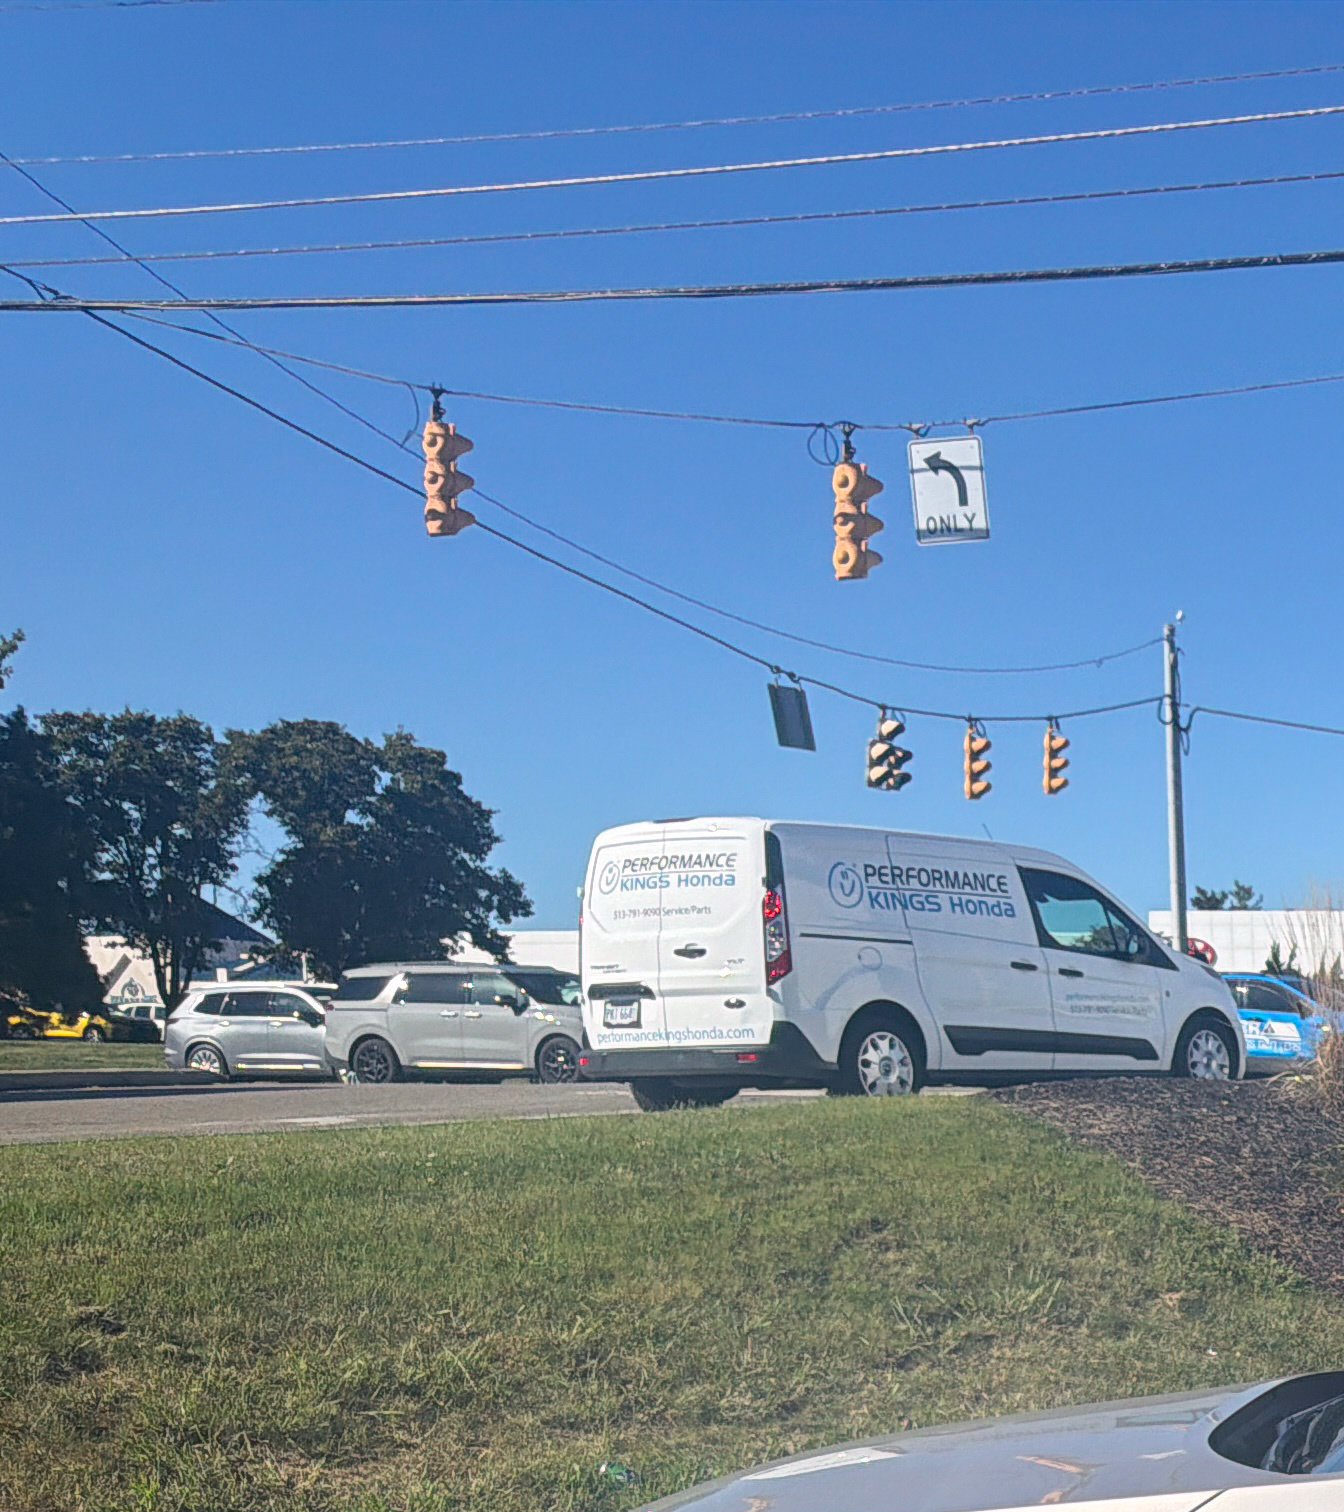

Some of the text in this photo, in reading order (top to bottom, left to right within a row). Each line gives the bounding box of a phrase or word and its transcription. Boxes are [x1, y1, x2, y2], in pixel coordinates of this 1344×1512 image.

[925, 512, 976, 535] ONLY
[621, 852, 738, 874] PERFORMANCE
[620, 872, 736, 892] KINGS Honda
[863, 863, 1009, 894] PERFORMANCE
[867, 890, 1016, 918] KINGS Honda
